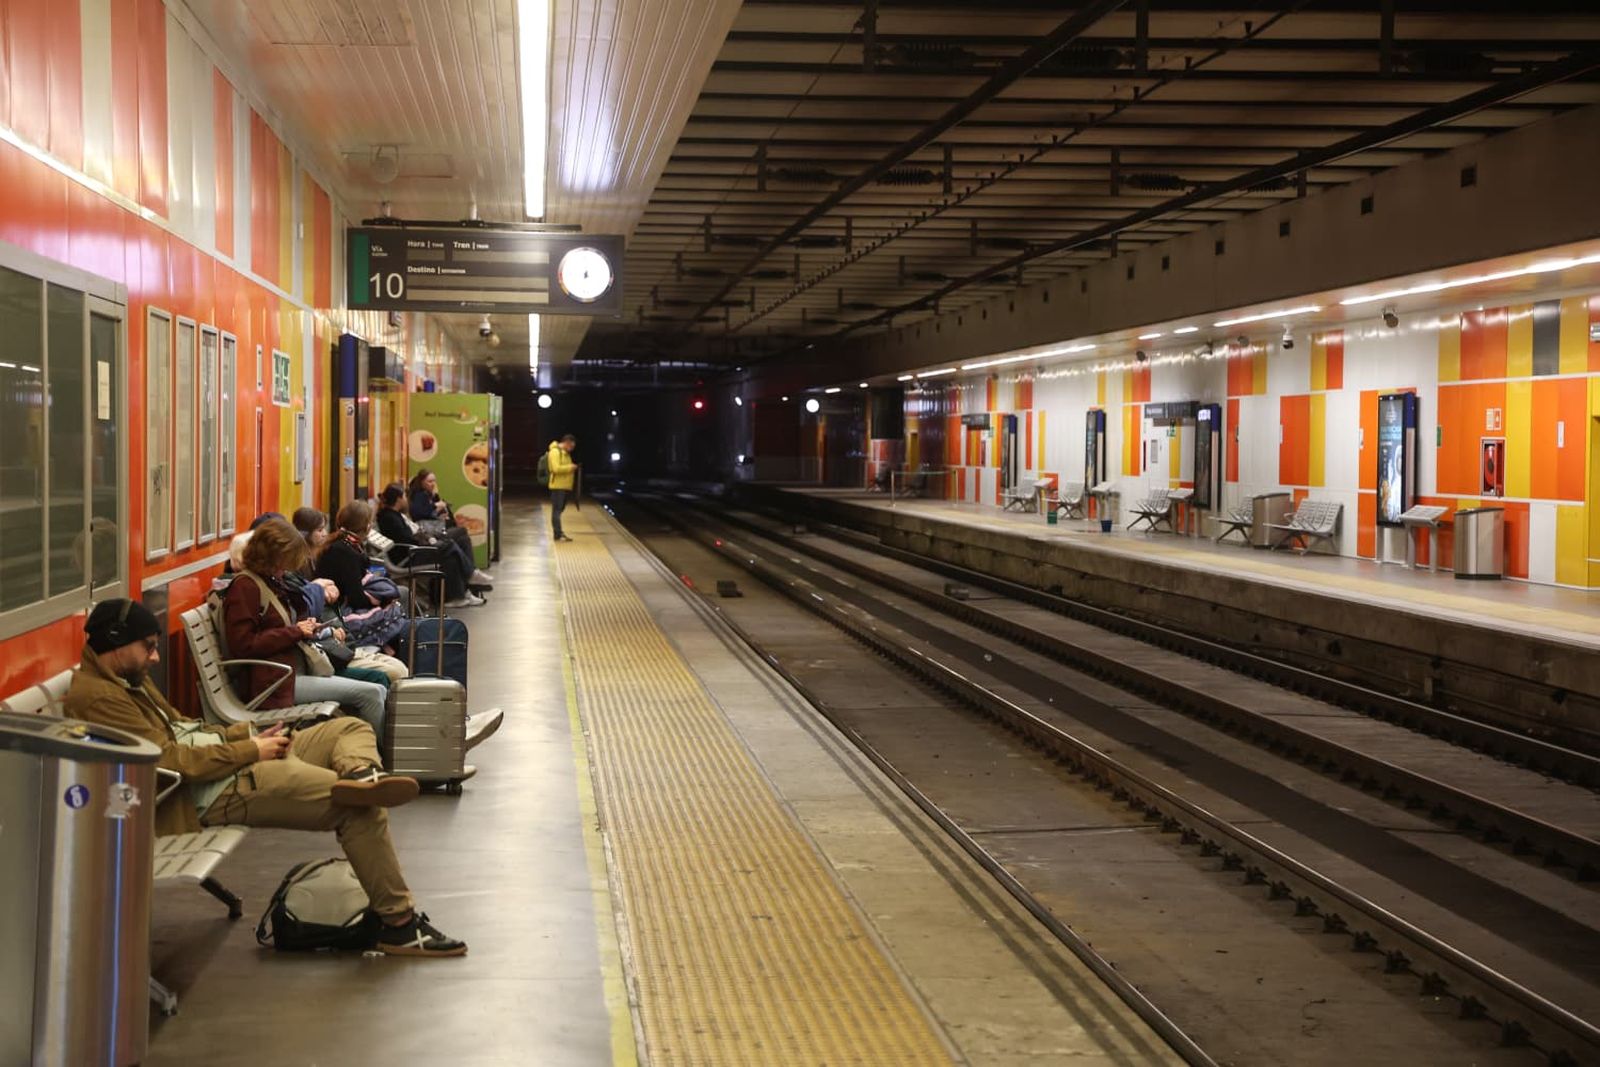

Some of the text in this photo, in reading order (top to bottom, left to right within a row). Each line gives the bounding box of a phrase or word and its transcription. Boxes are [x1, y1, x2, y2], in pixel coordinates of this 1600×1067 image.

[407, 240, 425, 248] Hora
[453, 241, 470, 249] Tren
[407, 265, 436, 273] Destino
[370, 272, 404, 299] 10
